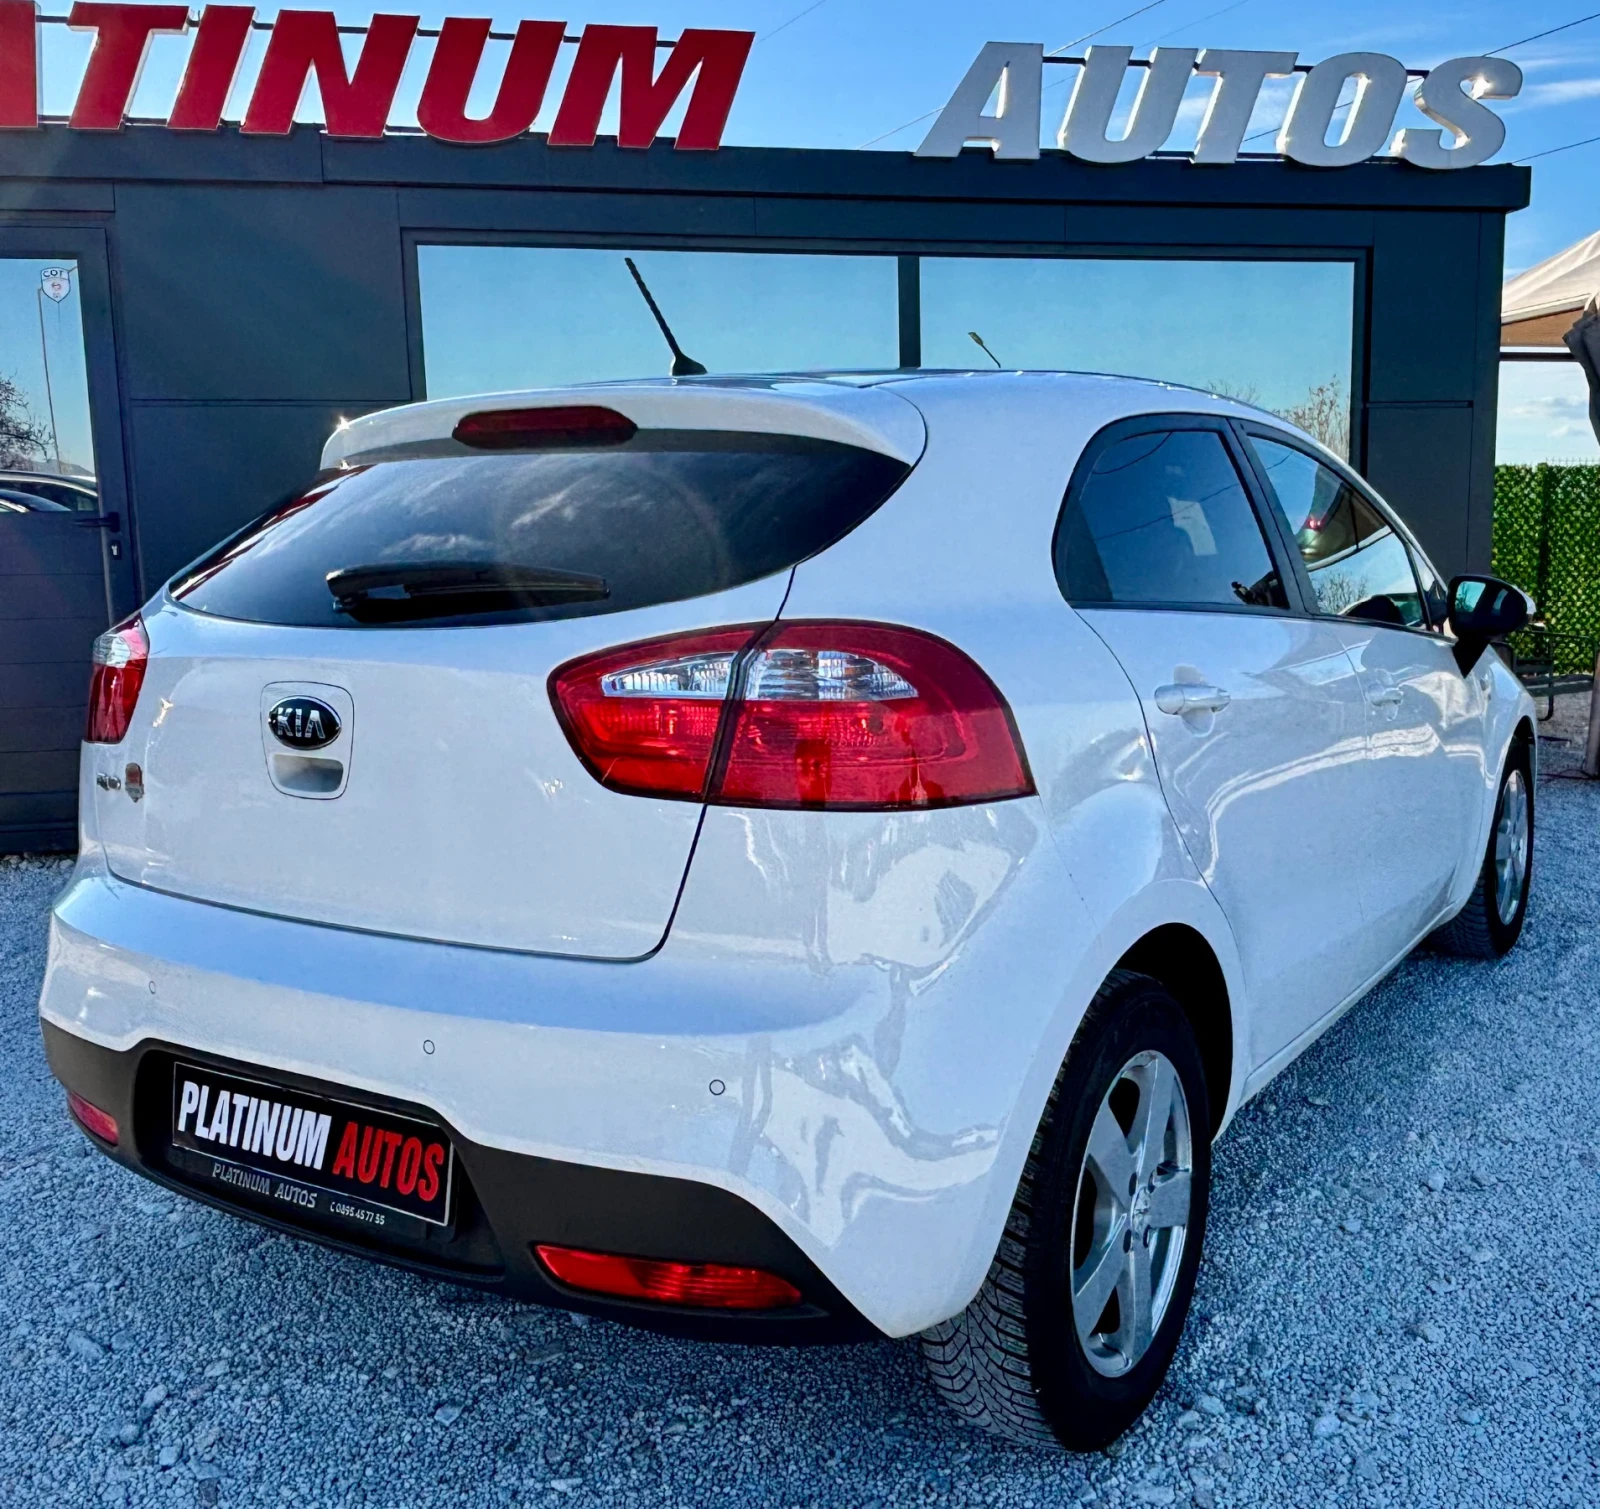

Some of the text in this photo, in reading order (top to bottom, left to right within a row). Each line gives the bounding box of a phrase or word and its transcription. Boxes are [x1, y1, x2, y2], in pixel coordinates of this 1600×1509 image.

[912, 41, 1523, 170] AUTOS
[277, 706, 326, 739] KIA
[177, 1080, 444, 1202] PLATINUM AUTOS
[211, 1162, 318, 1209] PLATINUM AUTOS
